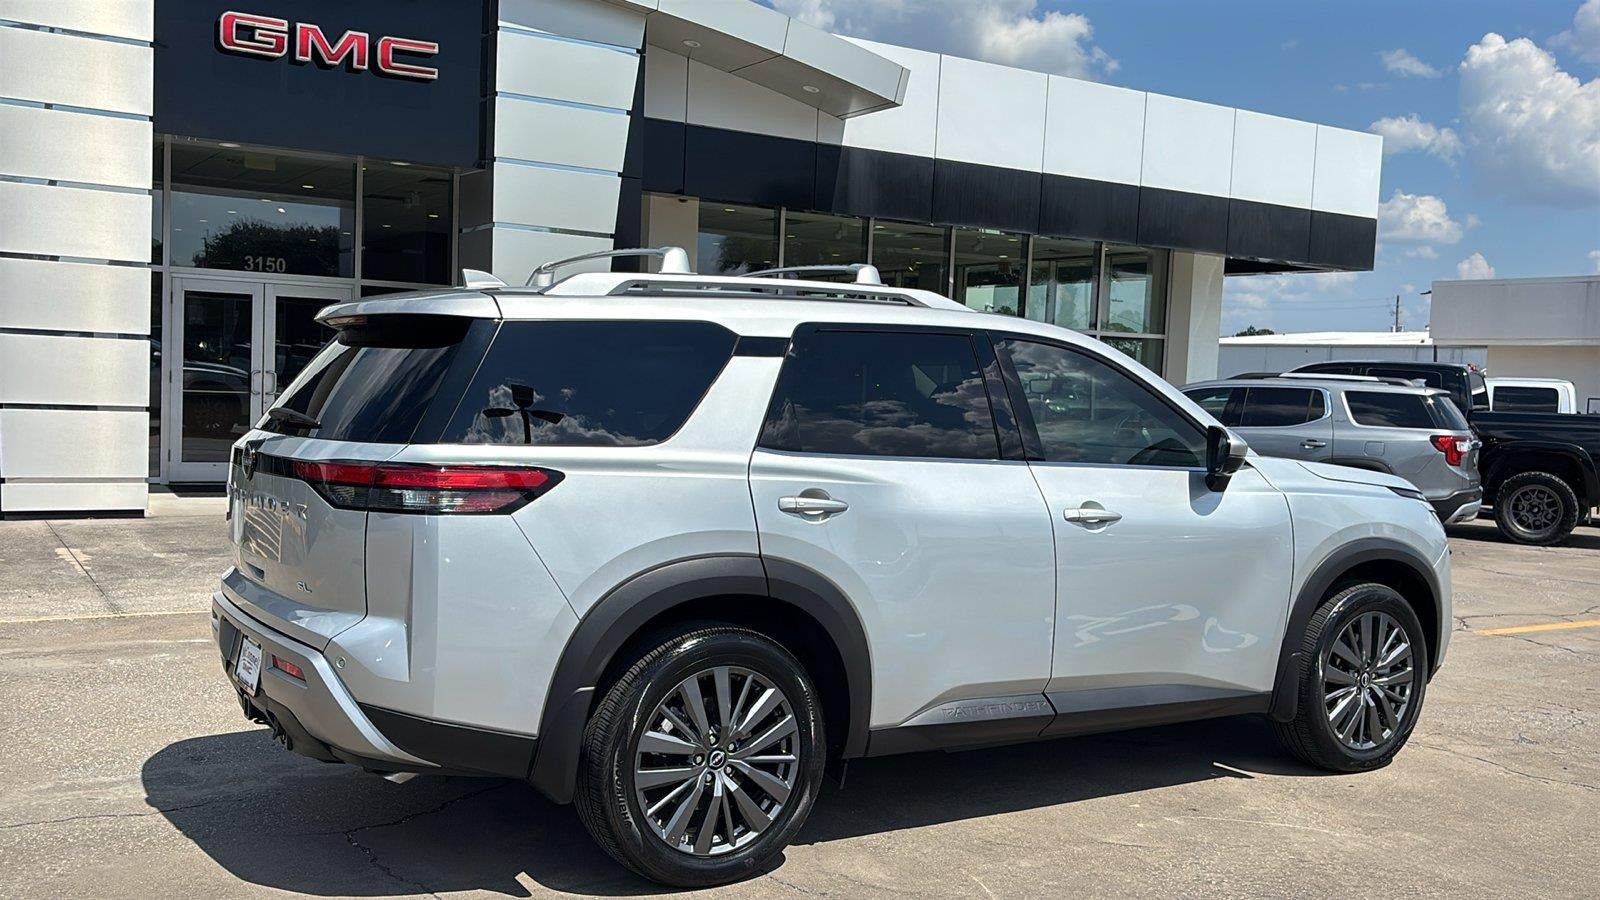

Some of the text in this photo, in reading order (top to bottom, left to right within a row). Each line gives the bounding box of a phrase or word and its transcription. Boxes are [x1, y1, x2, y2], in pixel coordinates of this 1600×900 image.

[219, 11, 439, 79] GMC
[244, 255, 286, 272] 3150
[297, 581, 312, 593] SL
[941, 701, 1047, 717] PATHFINDER
